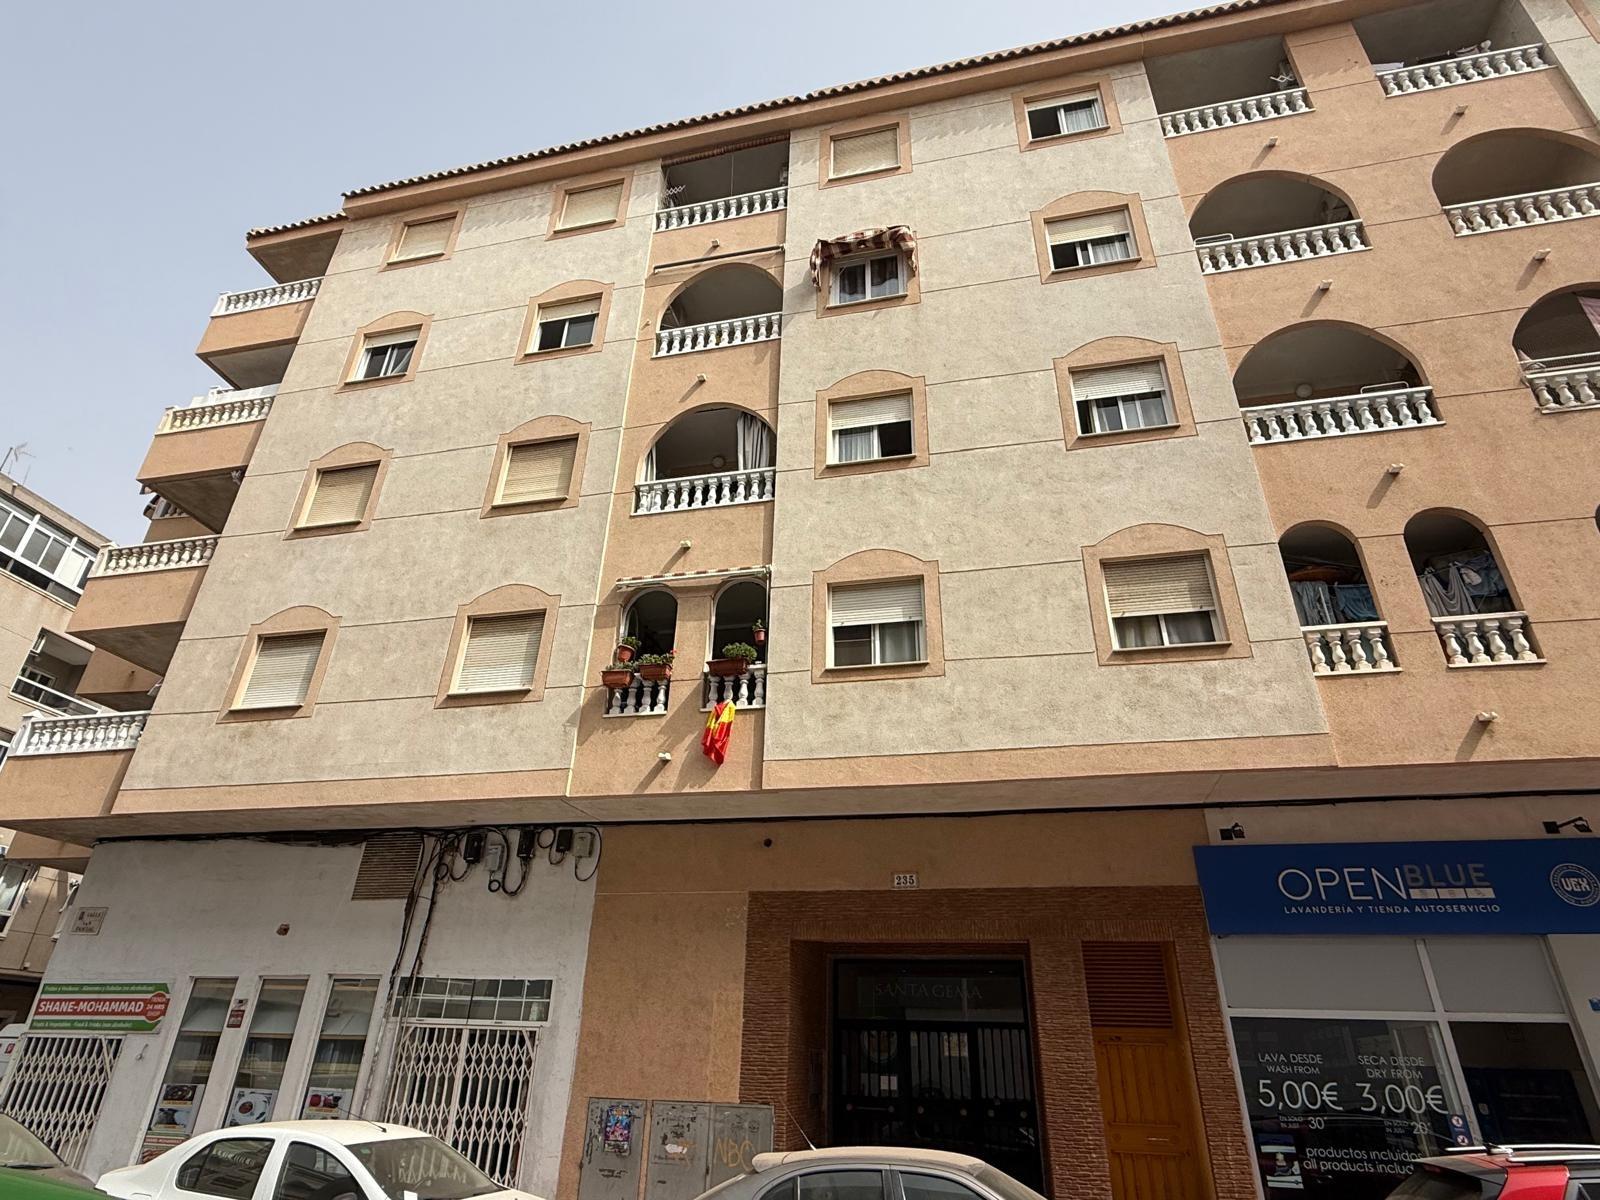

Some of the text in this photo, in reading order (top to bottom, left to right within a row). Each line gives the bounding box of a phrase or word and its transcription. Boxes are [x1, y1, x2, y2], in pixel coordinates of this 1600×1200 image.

[895, 875, 915, 886] 235
[1356, 905, 1364, 914] Y
[1368, 904, 1410, 914] TIENDA
[1414, 903, 1501, 913] AUTOSERVICIO
[875, 983, 929, 998] SANTA
[38, 1001, 144, 1013] SHANE-MOHAMMAD
[1258, 1052, 1324, 1065] LAVA DESDE
[1358, 1055, 1425, 1067] SECA DESDE
[1266, 1065, 1321, 1075] WASH FROM
[1366, 1068, 1424, 1079] DRY FROM
[1258, 1080, 1344, 1111] 5,00€
[1355, 1083, 1449, 1115] 3,00€
[1305, 1147, 1368, 1159] productos
[1303, 1159, 1318, 1170] all
[1319, 1160, 1375, 1173] products
